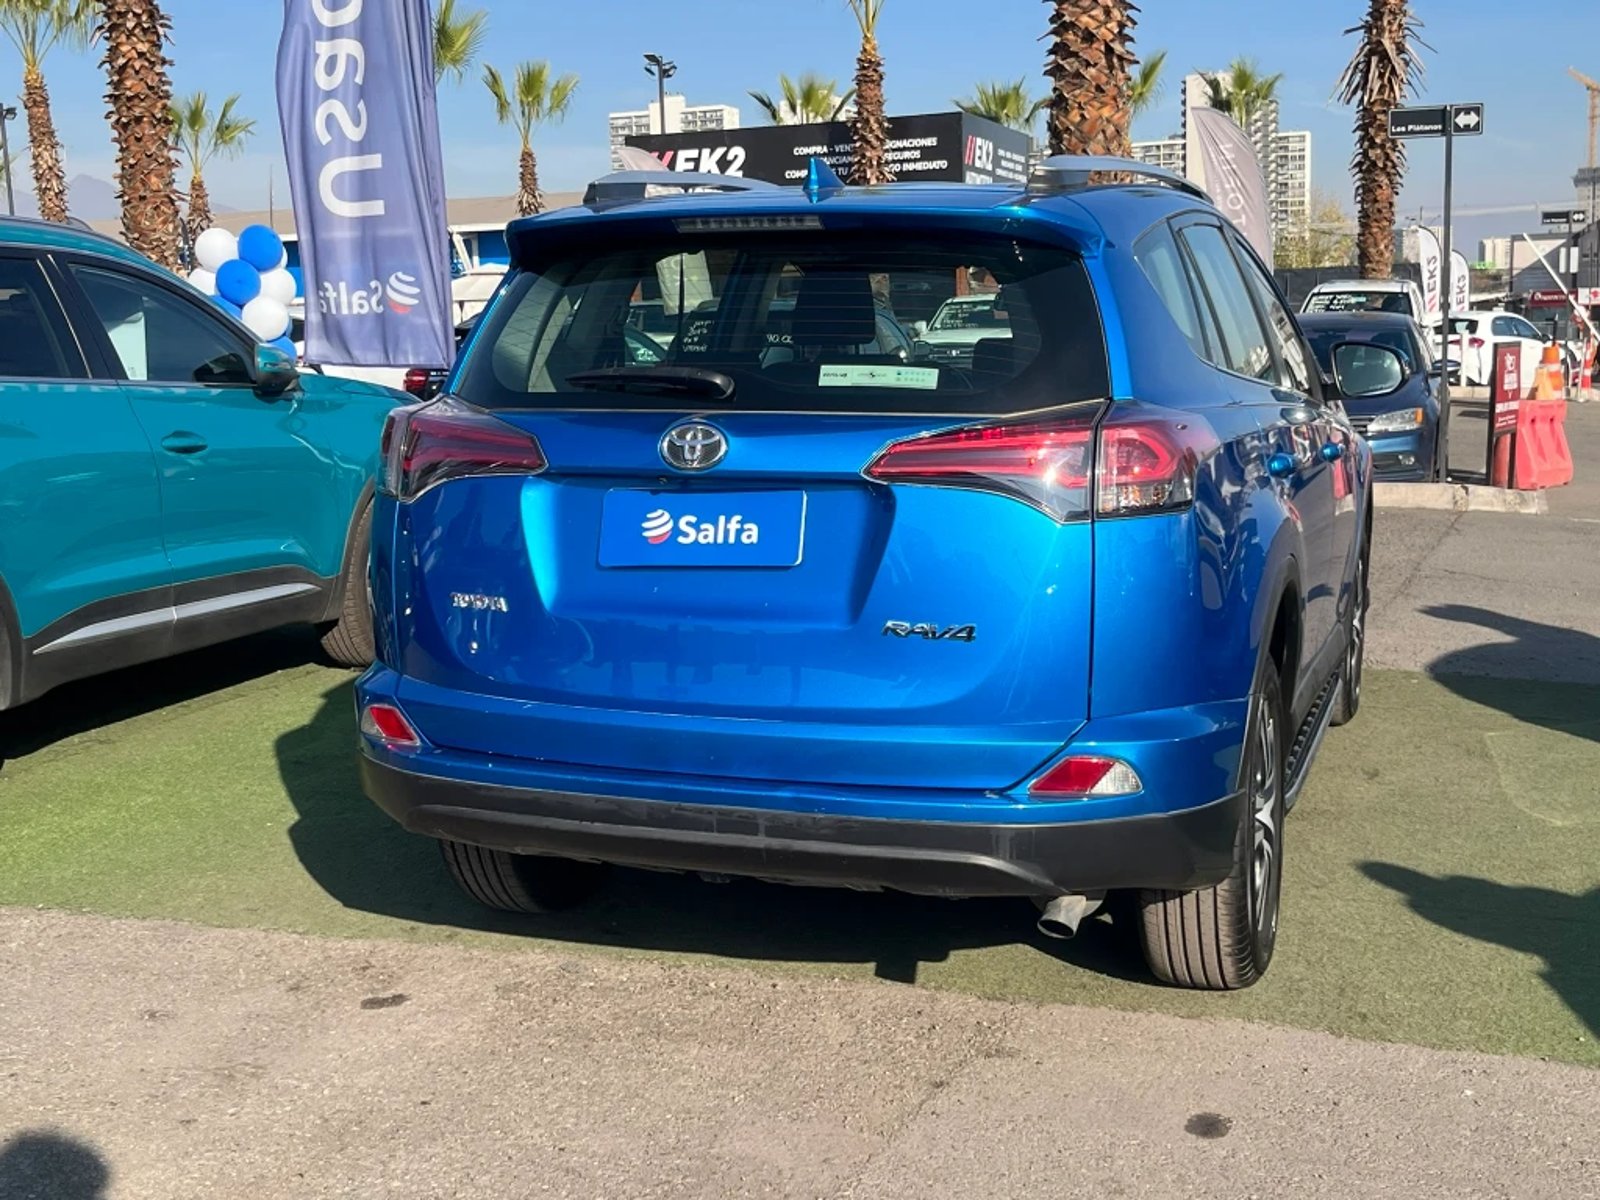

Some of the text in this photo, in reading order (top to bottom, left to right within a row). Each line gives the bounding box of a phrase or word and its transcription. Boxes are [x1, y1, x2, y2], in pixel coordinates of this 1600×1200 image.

[793, 145, 829, 156] COMPRA
[884, 150, 921, 161] SEGUROS
[902, 160, 948, 171] INMEDIATO
[677, 514, 758, 544] Salfa
[882, 619, 976, 642] RAV4
